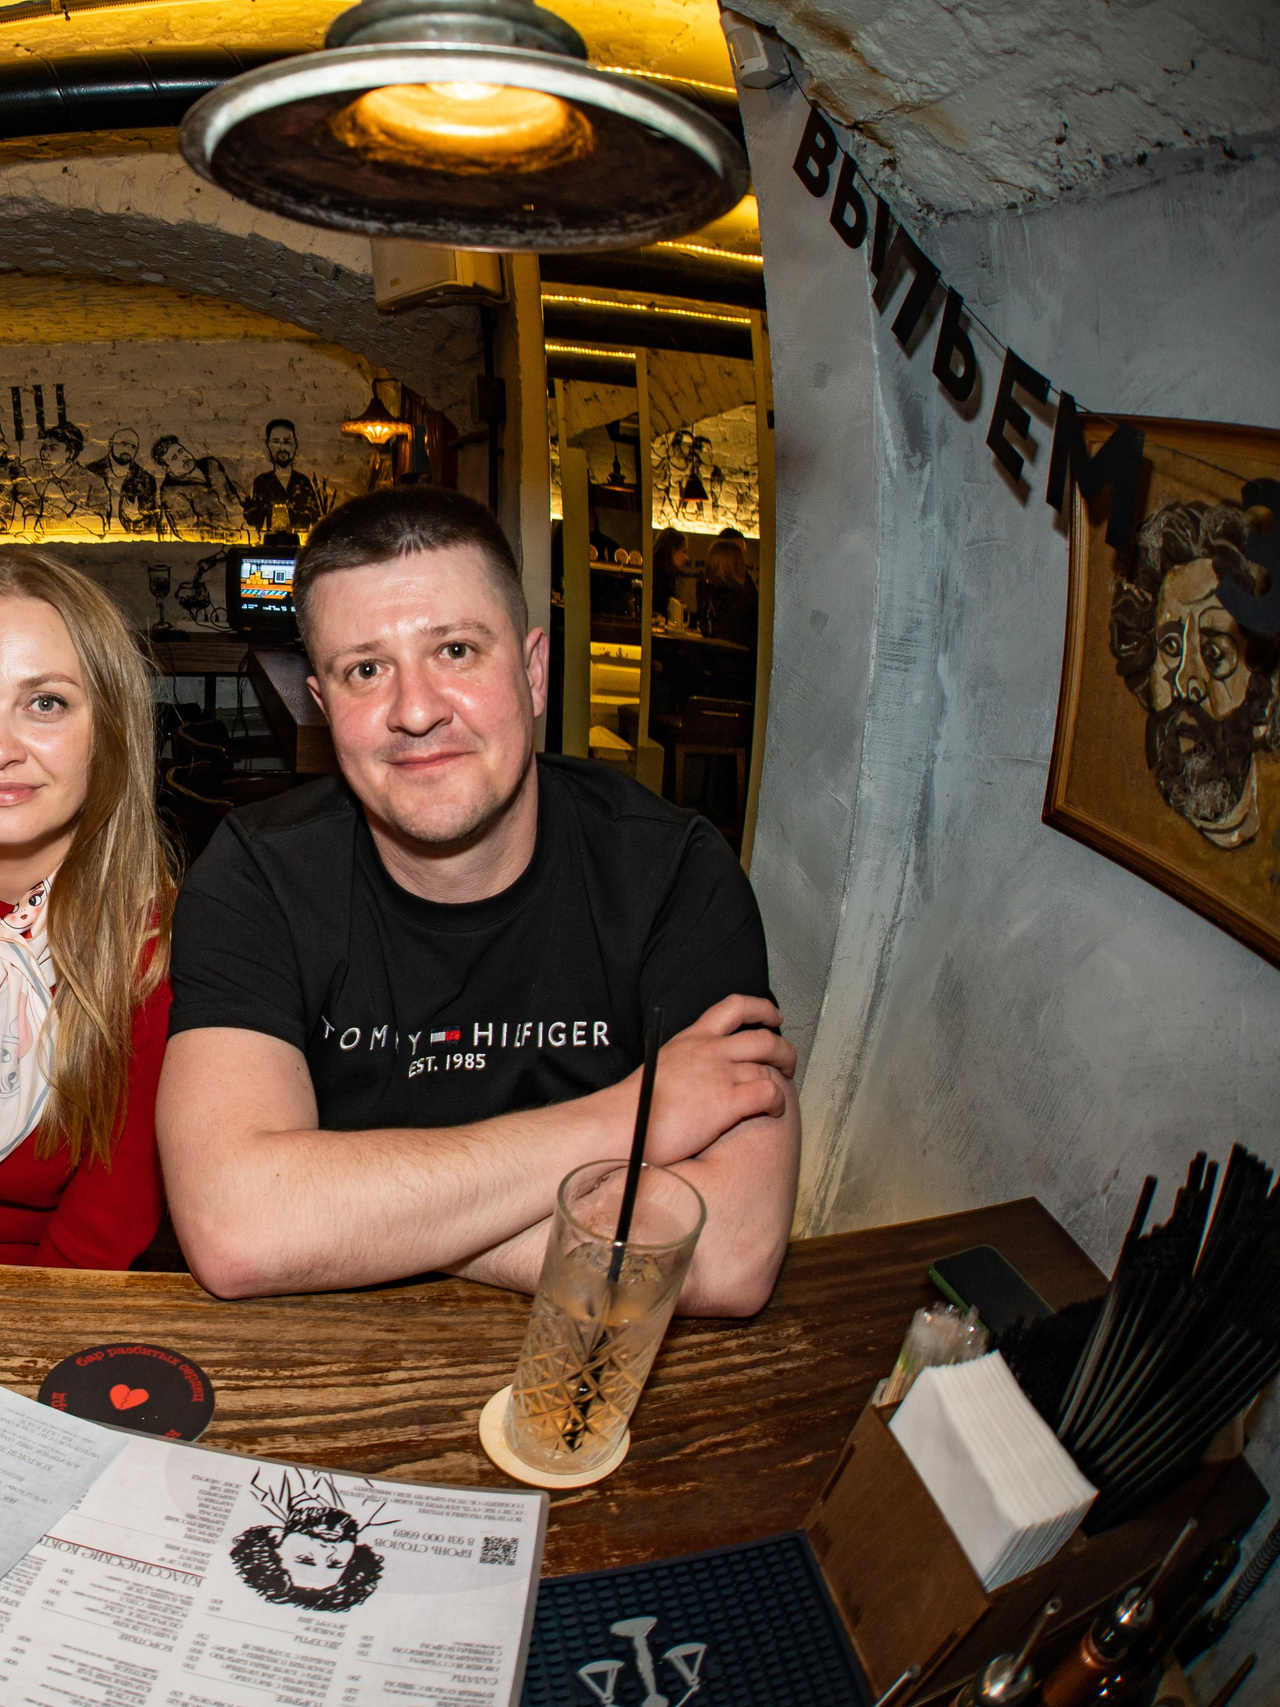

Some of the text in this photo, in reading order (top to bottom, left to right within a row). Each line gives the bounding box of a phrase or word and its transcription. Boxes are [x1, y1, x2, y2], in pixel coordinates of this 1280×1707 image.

[792, 106, 1145, 550] ВЫПЬЕМ
[321, 1015, 611, 1055] TOMY HILFIGER
[408, 1053, 486, 1078] EST. 1985
[76, 1350, 104, 1367] бар
[107, 1345, 181, 1366] разбитых
[373, 1537, 472, 1558] БРОНЬ СТОЛОВ
[392, 1528, 475, 1546] 8 931 000 6989
